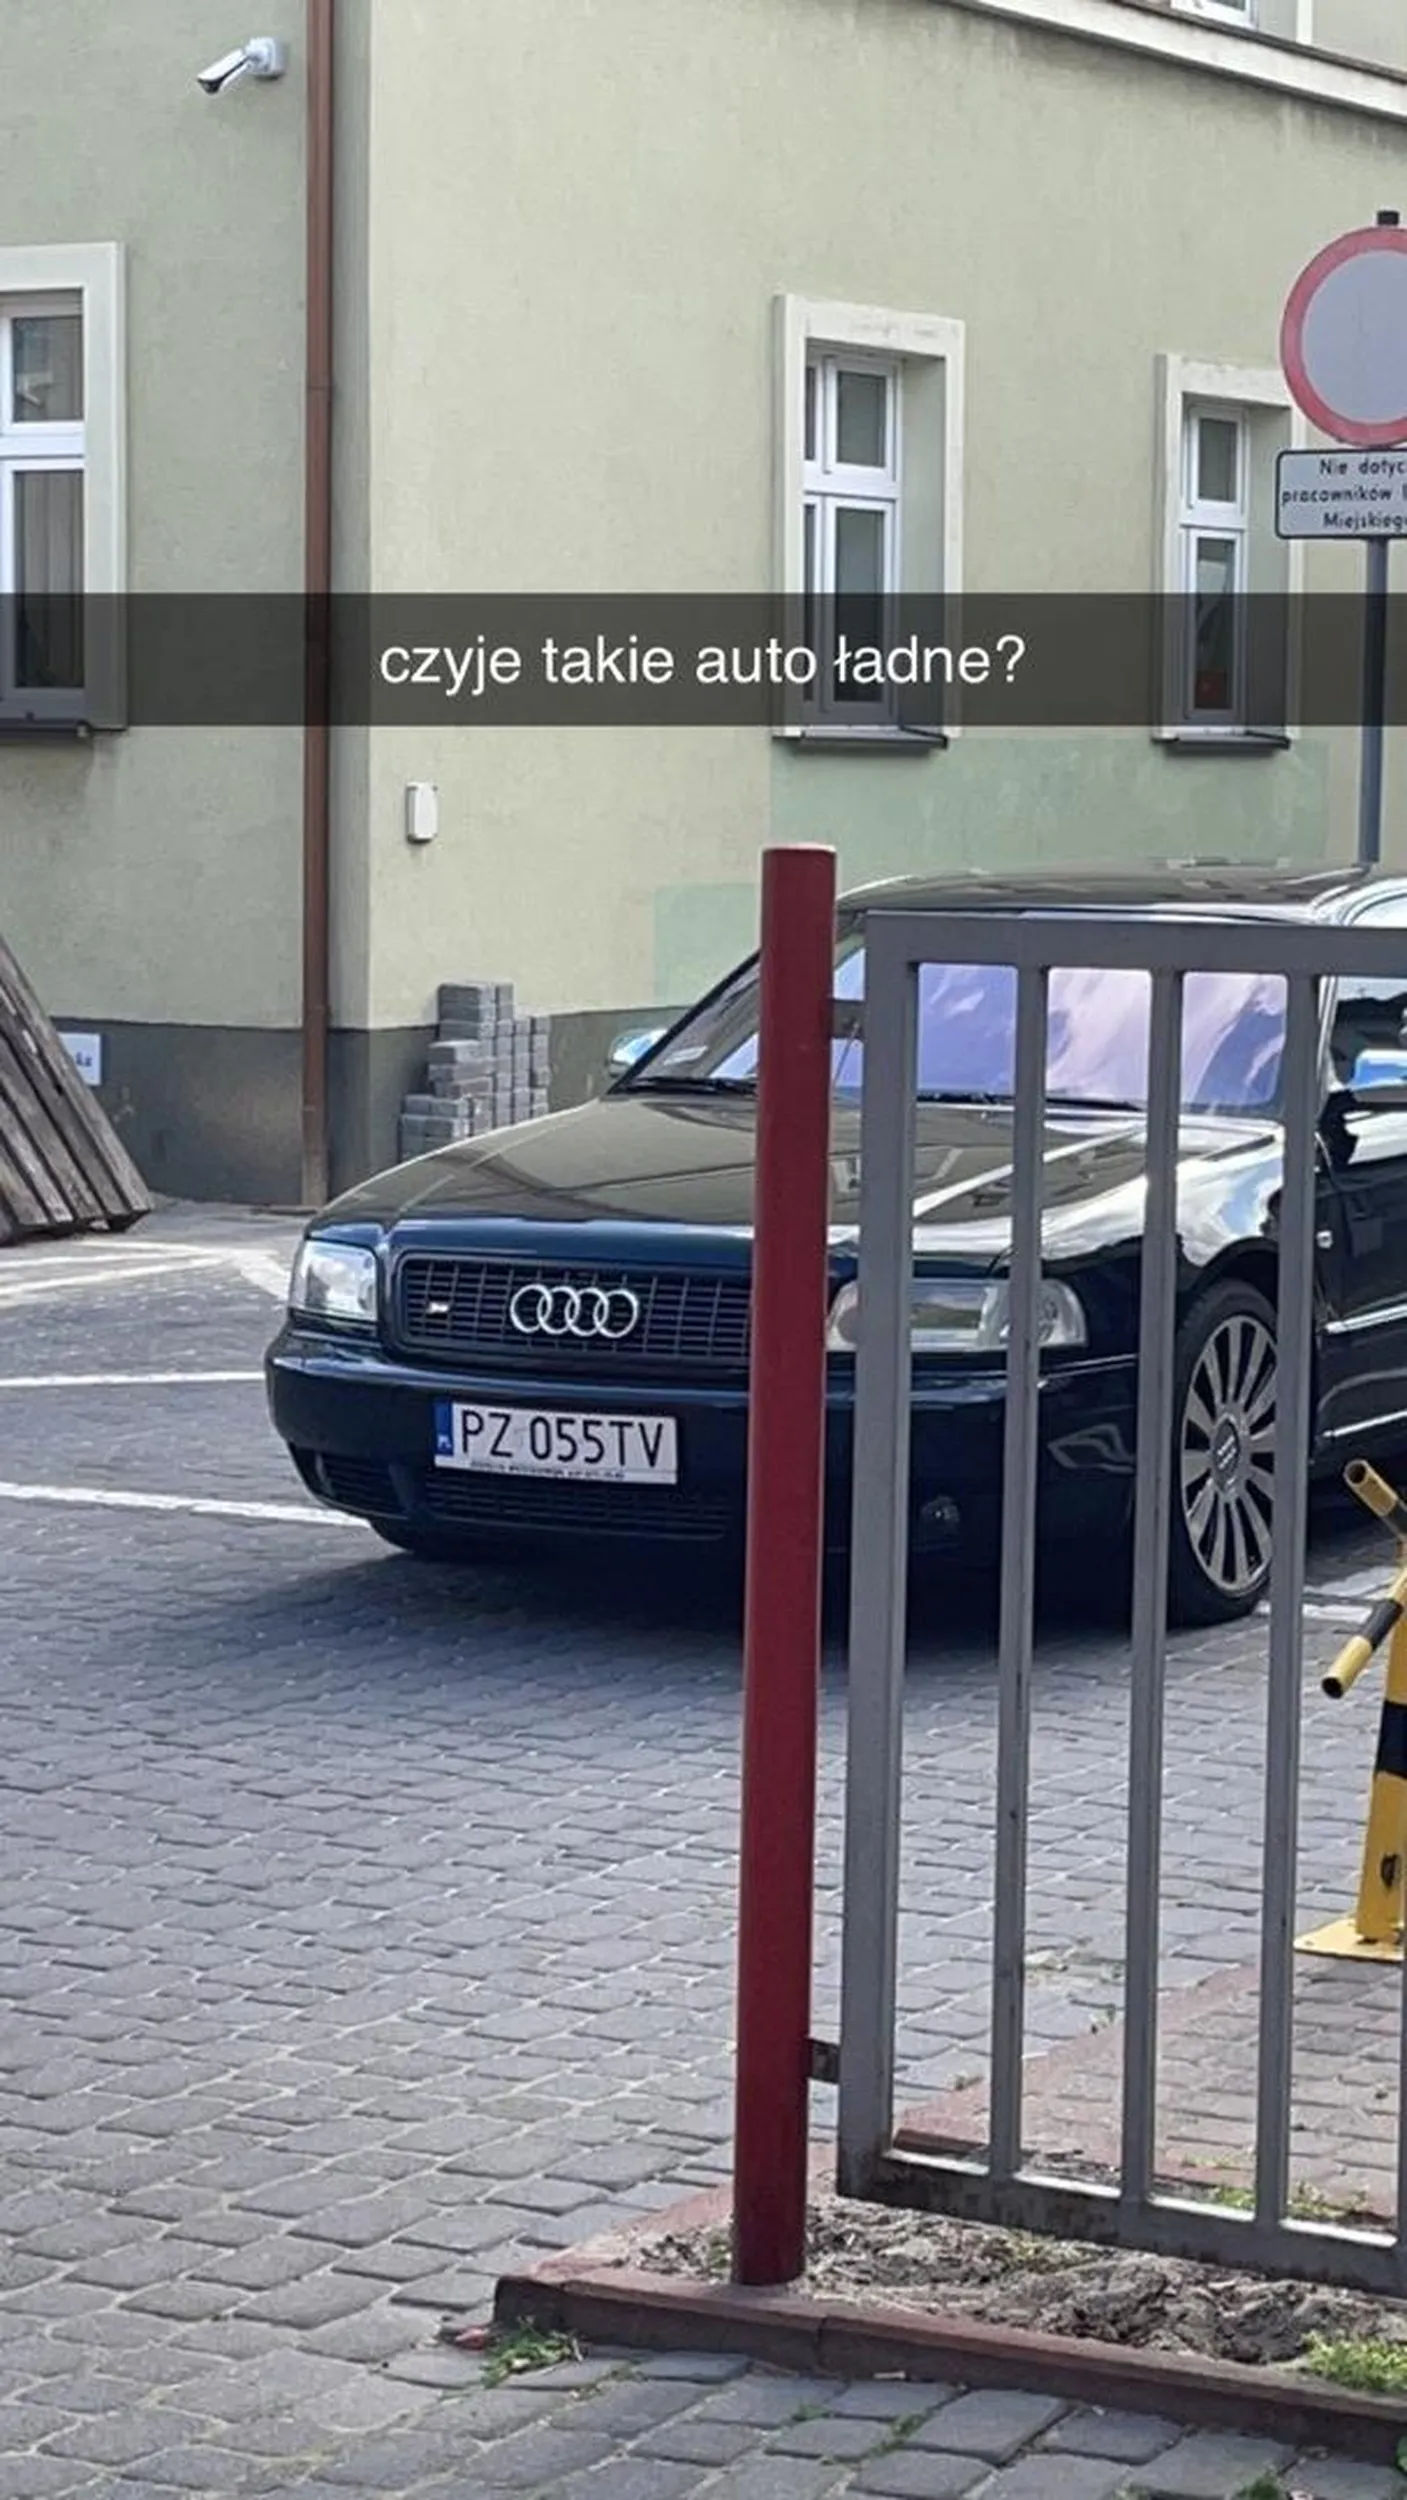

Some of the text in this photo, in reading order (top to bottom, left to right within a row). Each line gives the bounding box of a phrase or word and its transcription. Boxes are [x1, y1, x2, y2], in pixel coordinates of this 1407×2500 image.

[1320, 459, 1348, 475] Nie
[1323, 511, 1407, 533] Miejskieg
[460, 1409, 664, 1469] PZ 055TV
